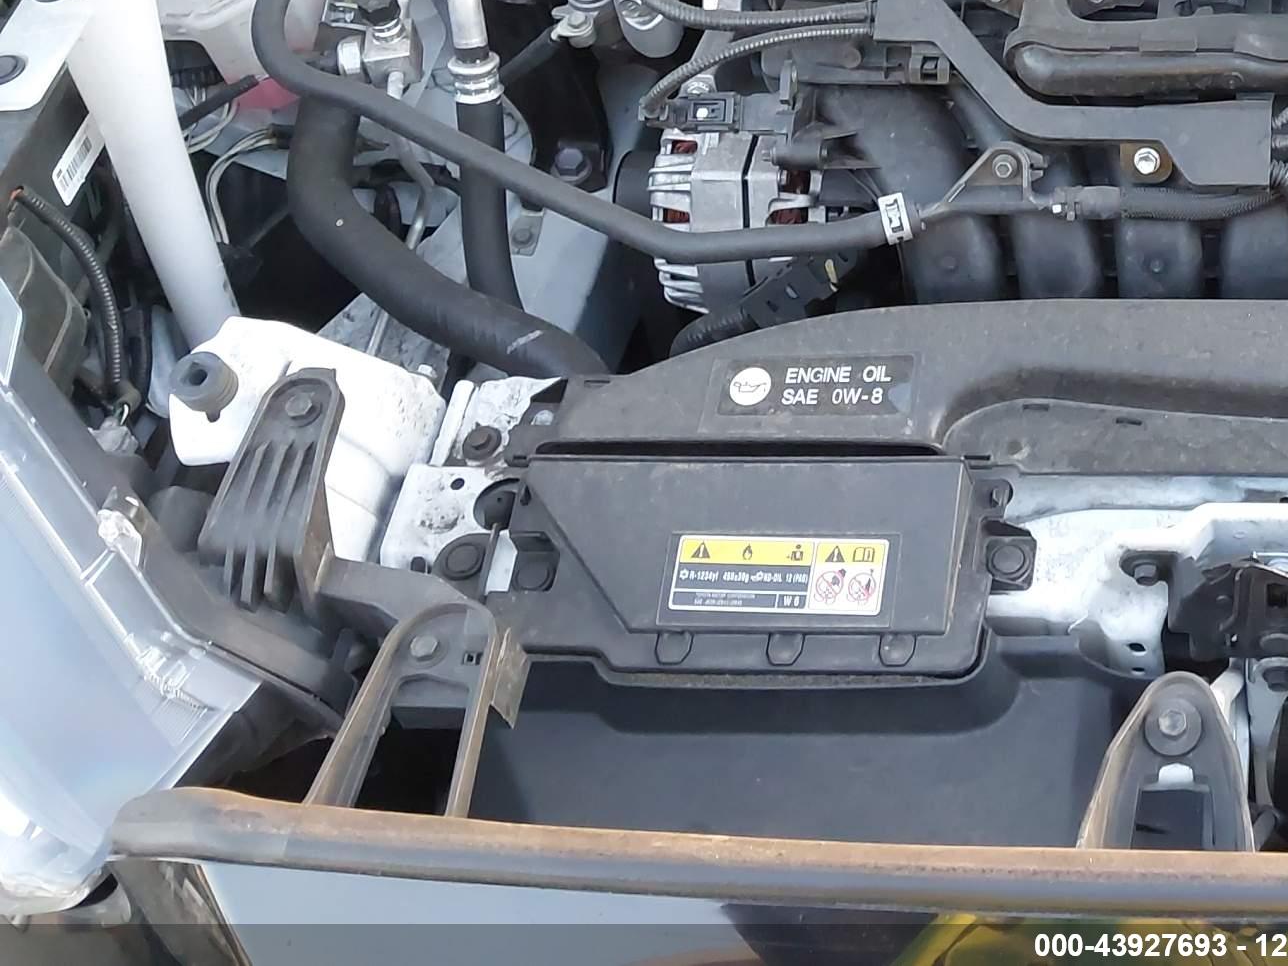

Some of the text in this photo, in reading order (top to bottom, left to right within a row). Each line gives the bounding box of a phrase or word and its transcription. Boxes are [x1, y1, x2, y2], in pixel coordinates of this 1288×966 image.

[785, 365, 892, 384] ENGINE OIL
[781, 387, 883, 405] SAE 0W-8
